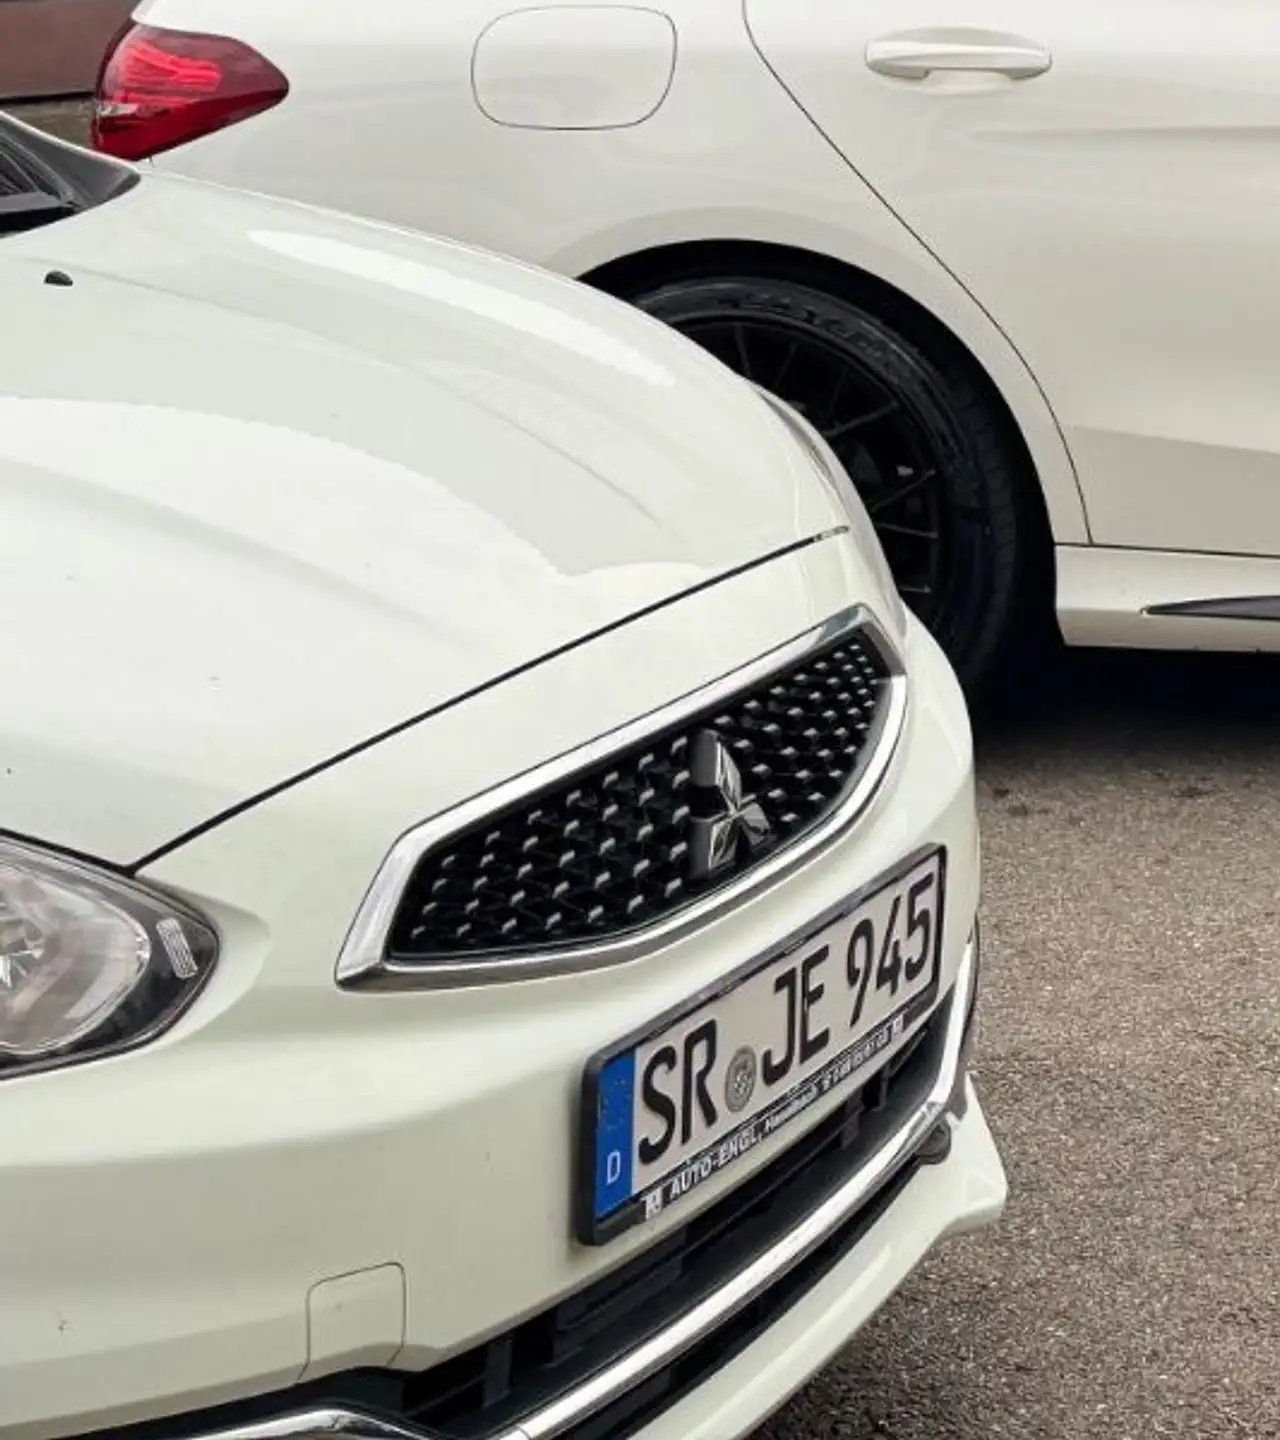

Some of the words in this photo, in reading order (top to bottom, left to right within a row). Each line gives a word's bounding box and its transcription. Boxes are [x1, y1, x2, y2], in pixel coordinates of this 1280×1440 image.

[638, 1018, 718, 1166] SR
[761, 944, 830, 1087] JE
[846, 872, 934, 1027] 945
[605, 1149, 622, 1186] D
